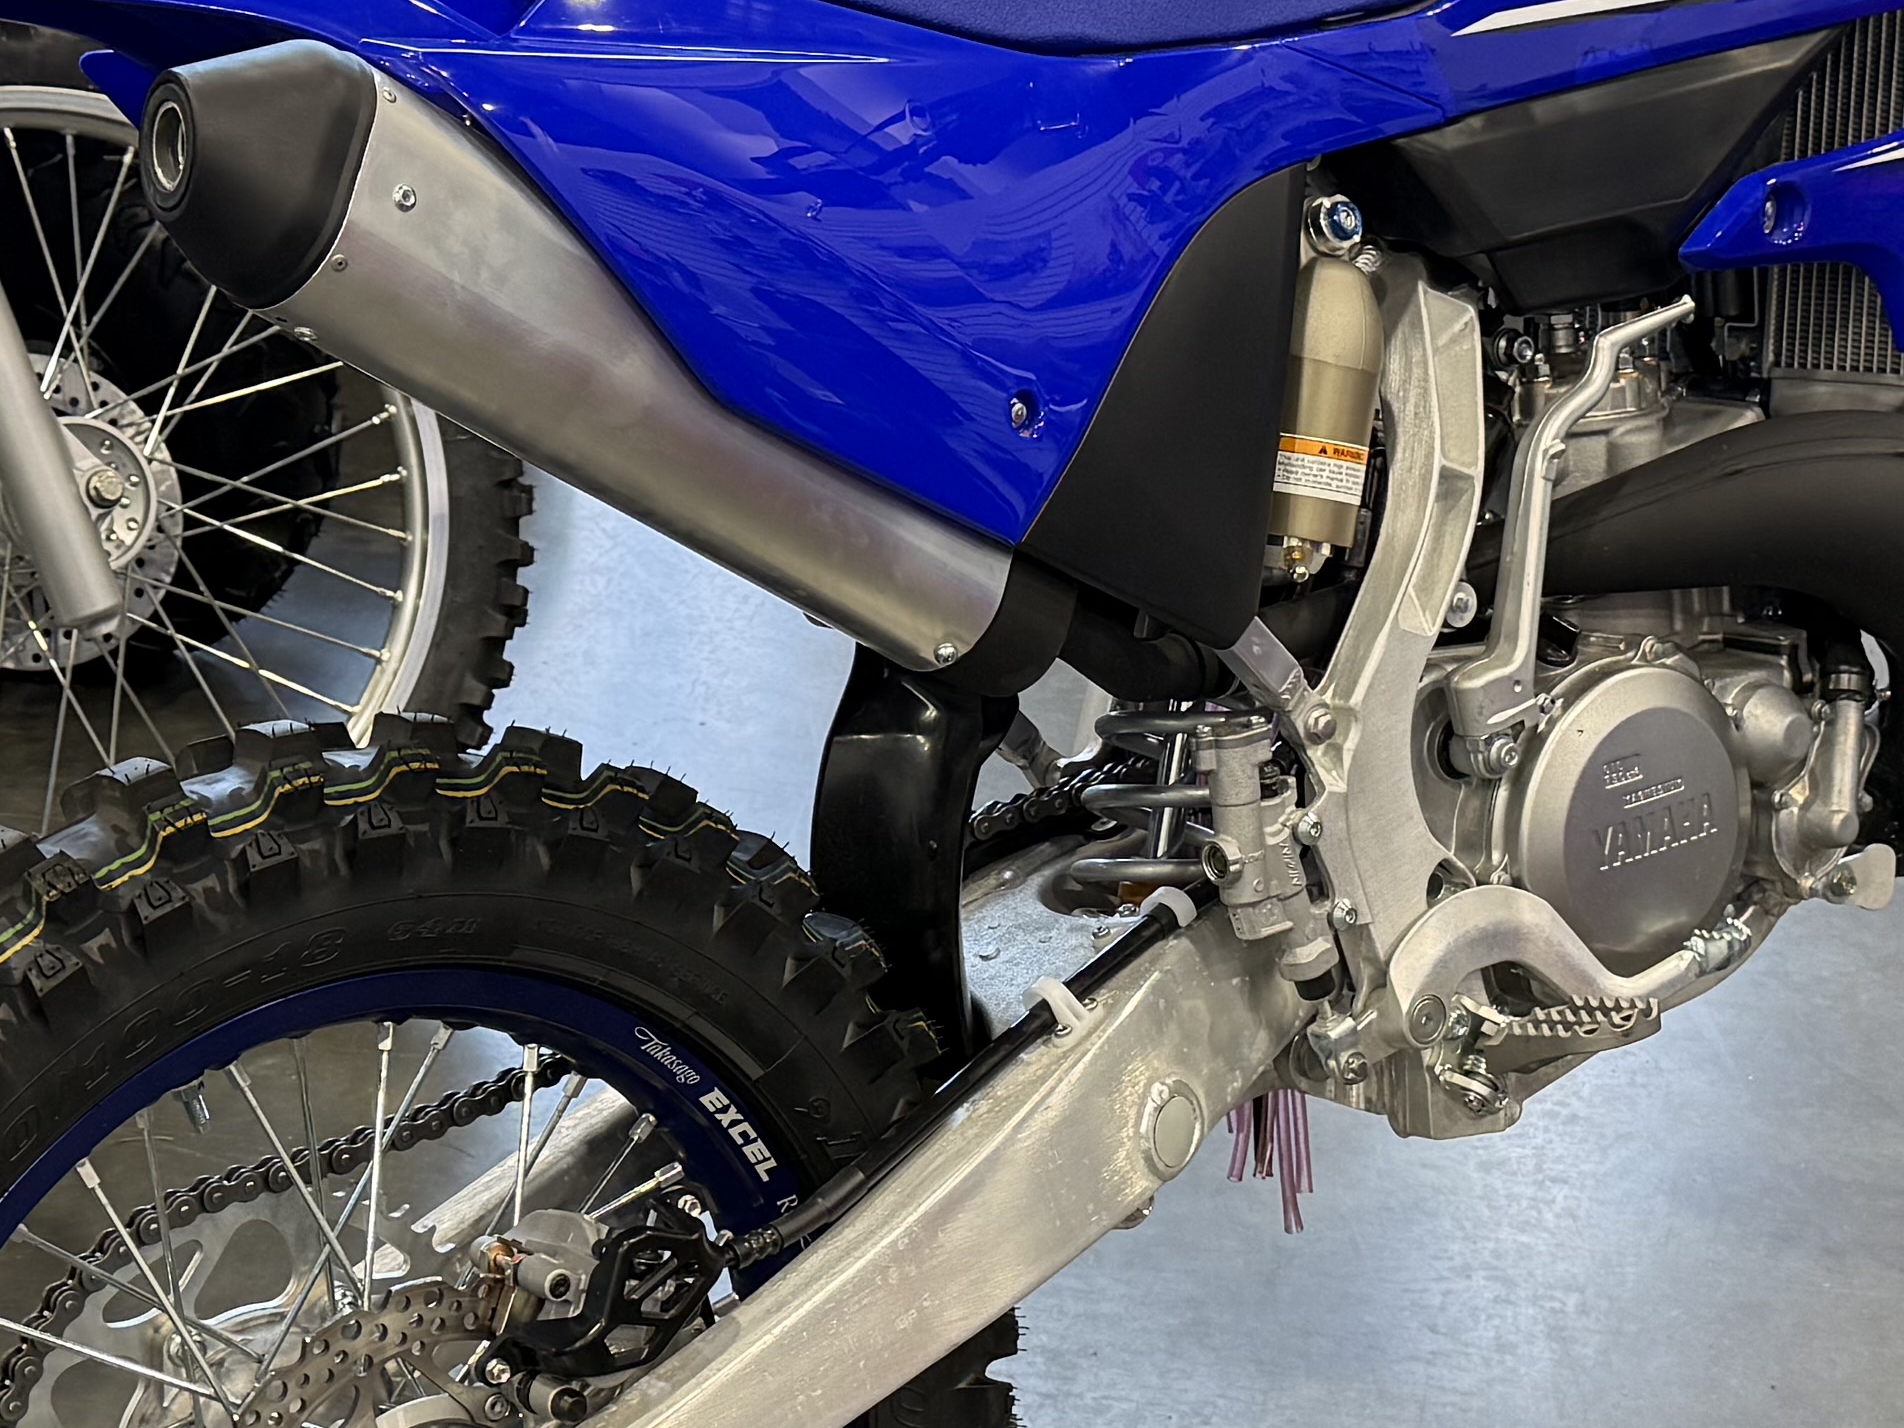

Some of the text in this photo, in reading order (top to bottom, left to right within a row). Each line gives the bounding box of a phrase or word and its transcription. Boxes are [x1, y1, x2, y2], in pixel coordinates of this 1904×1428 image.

[1592, 793, 1718, 870] YAMAHA
[634, 1026, 778, 1182] Takasago EXCEL
